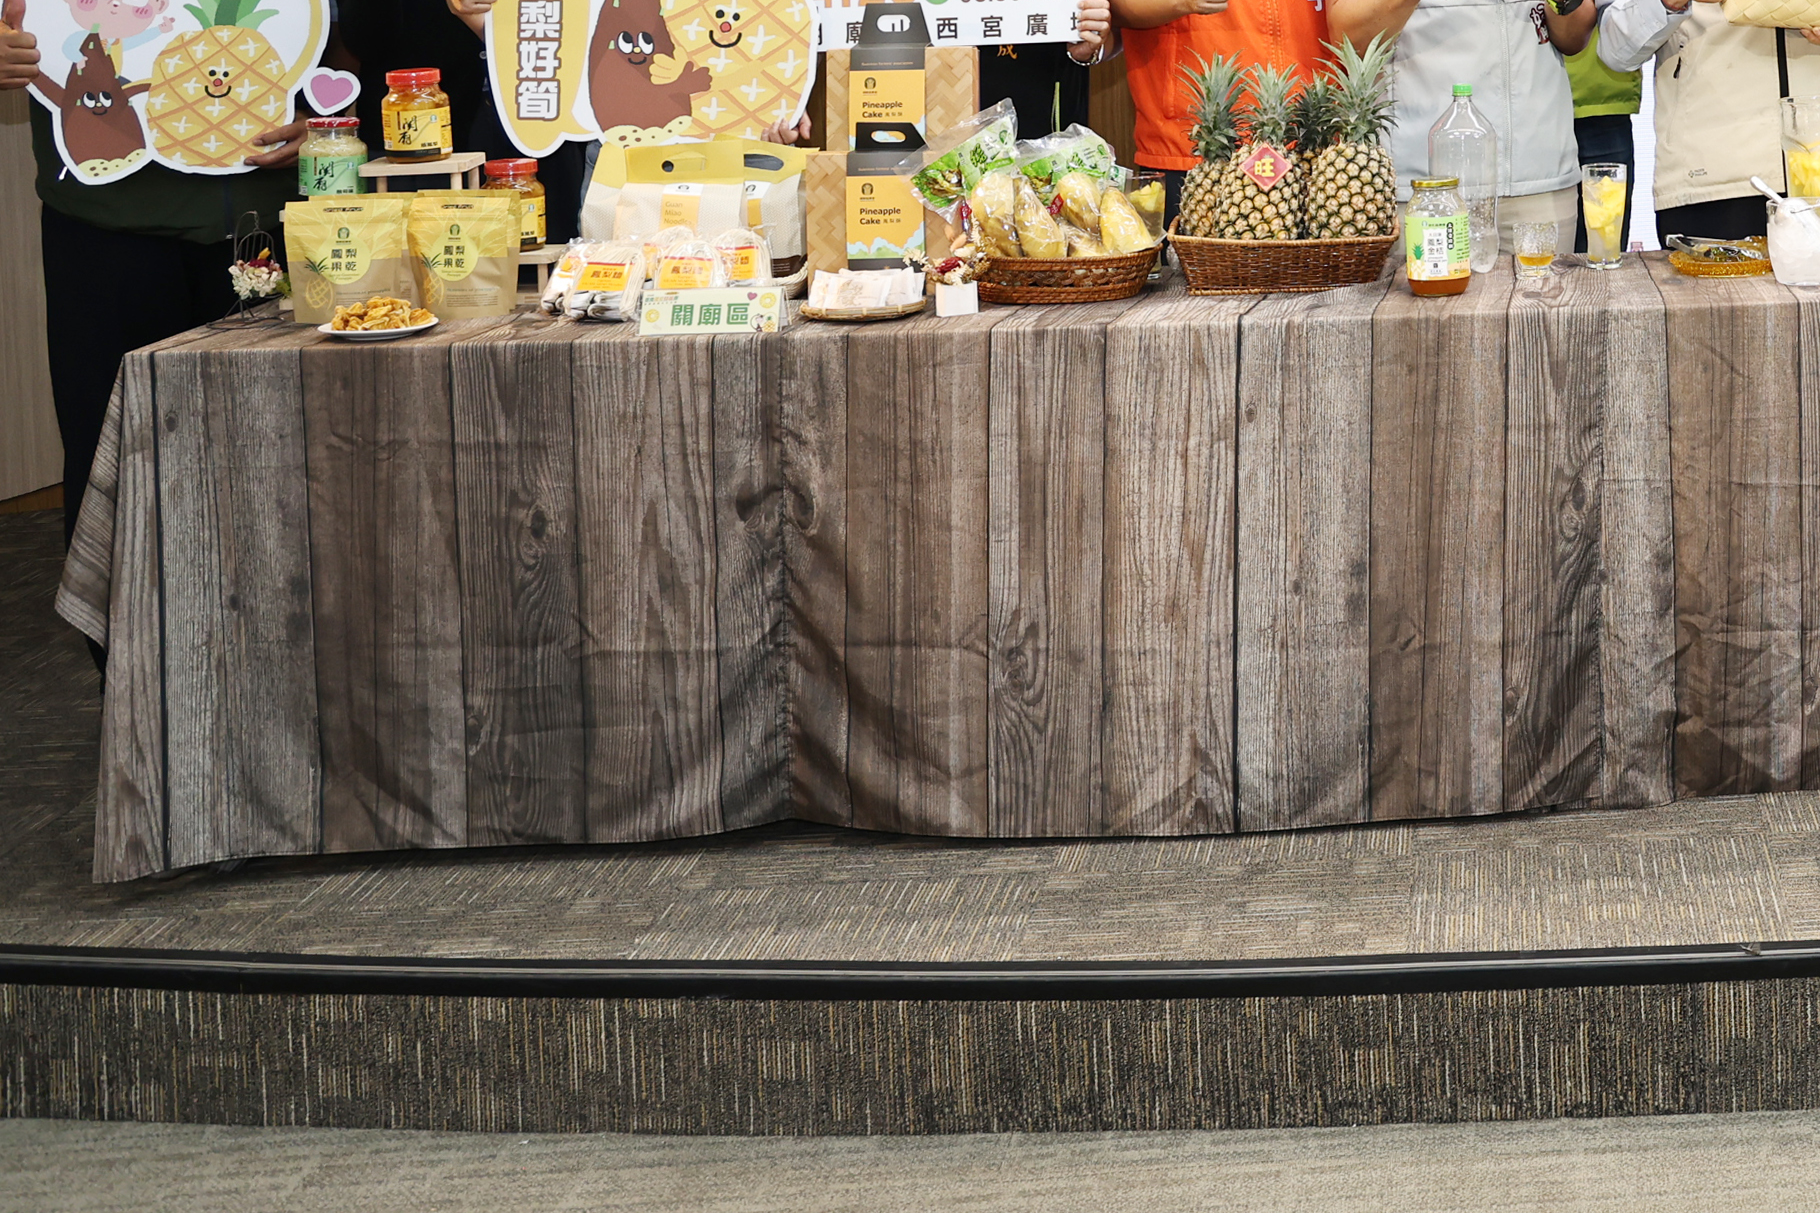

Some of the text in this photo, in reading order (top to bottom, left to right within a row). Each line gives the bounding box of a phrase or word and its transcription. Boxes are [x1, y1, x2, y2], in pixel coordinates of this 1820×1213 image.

[862, 100, 903, 109] Pineapple
[1253, 157, 1276, 177] 旺
[860, 207, 902, 216] Pineapple
[670, 302, 751, 327] 關廟區
